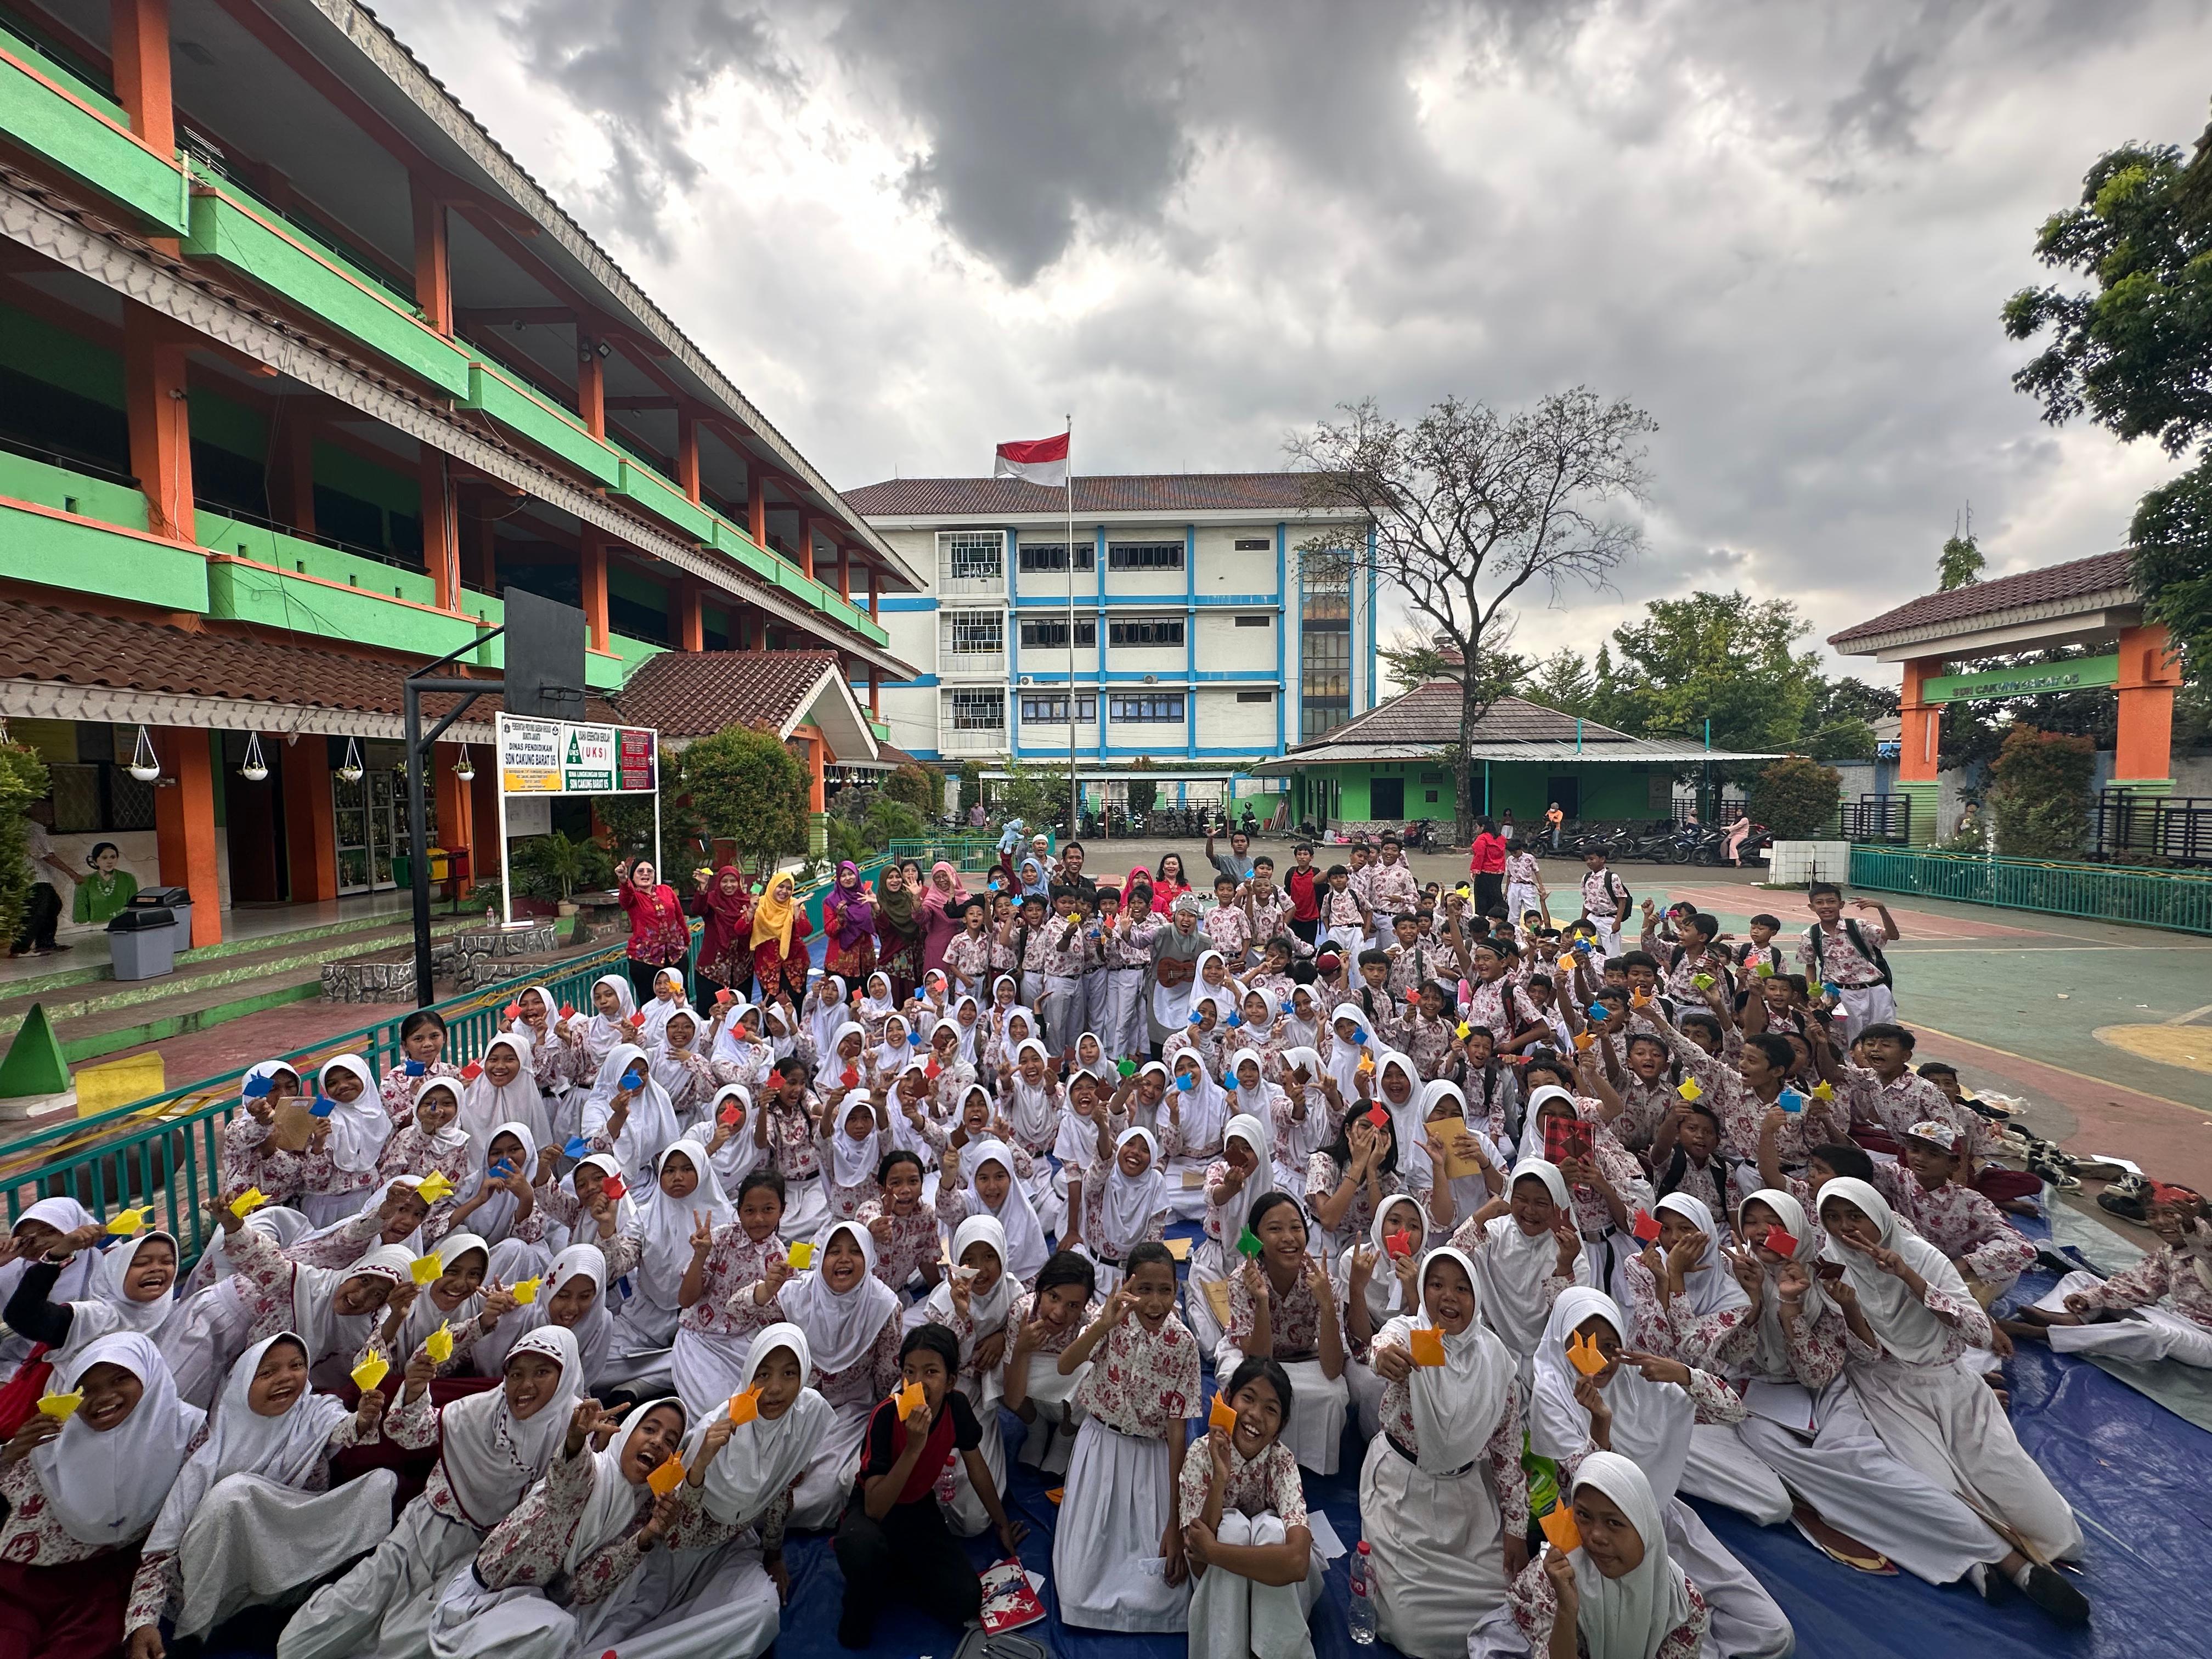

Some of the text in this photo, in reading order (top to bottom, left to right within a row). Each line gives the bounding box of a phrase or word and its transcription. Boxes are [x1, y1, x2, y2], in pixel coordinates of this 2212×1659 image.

[509, 742, 552, 752] DINAS PENDIDIKAN
[505, 753, 556, 766] SDN CAKUNG BARAT 05
